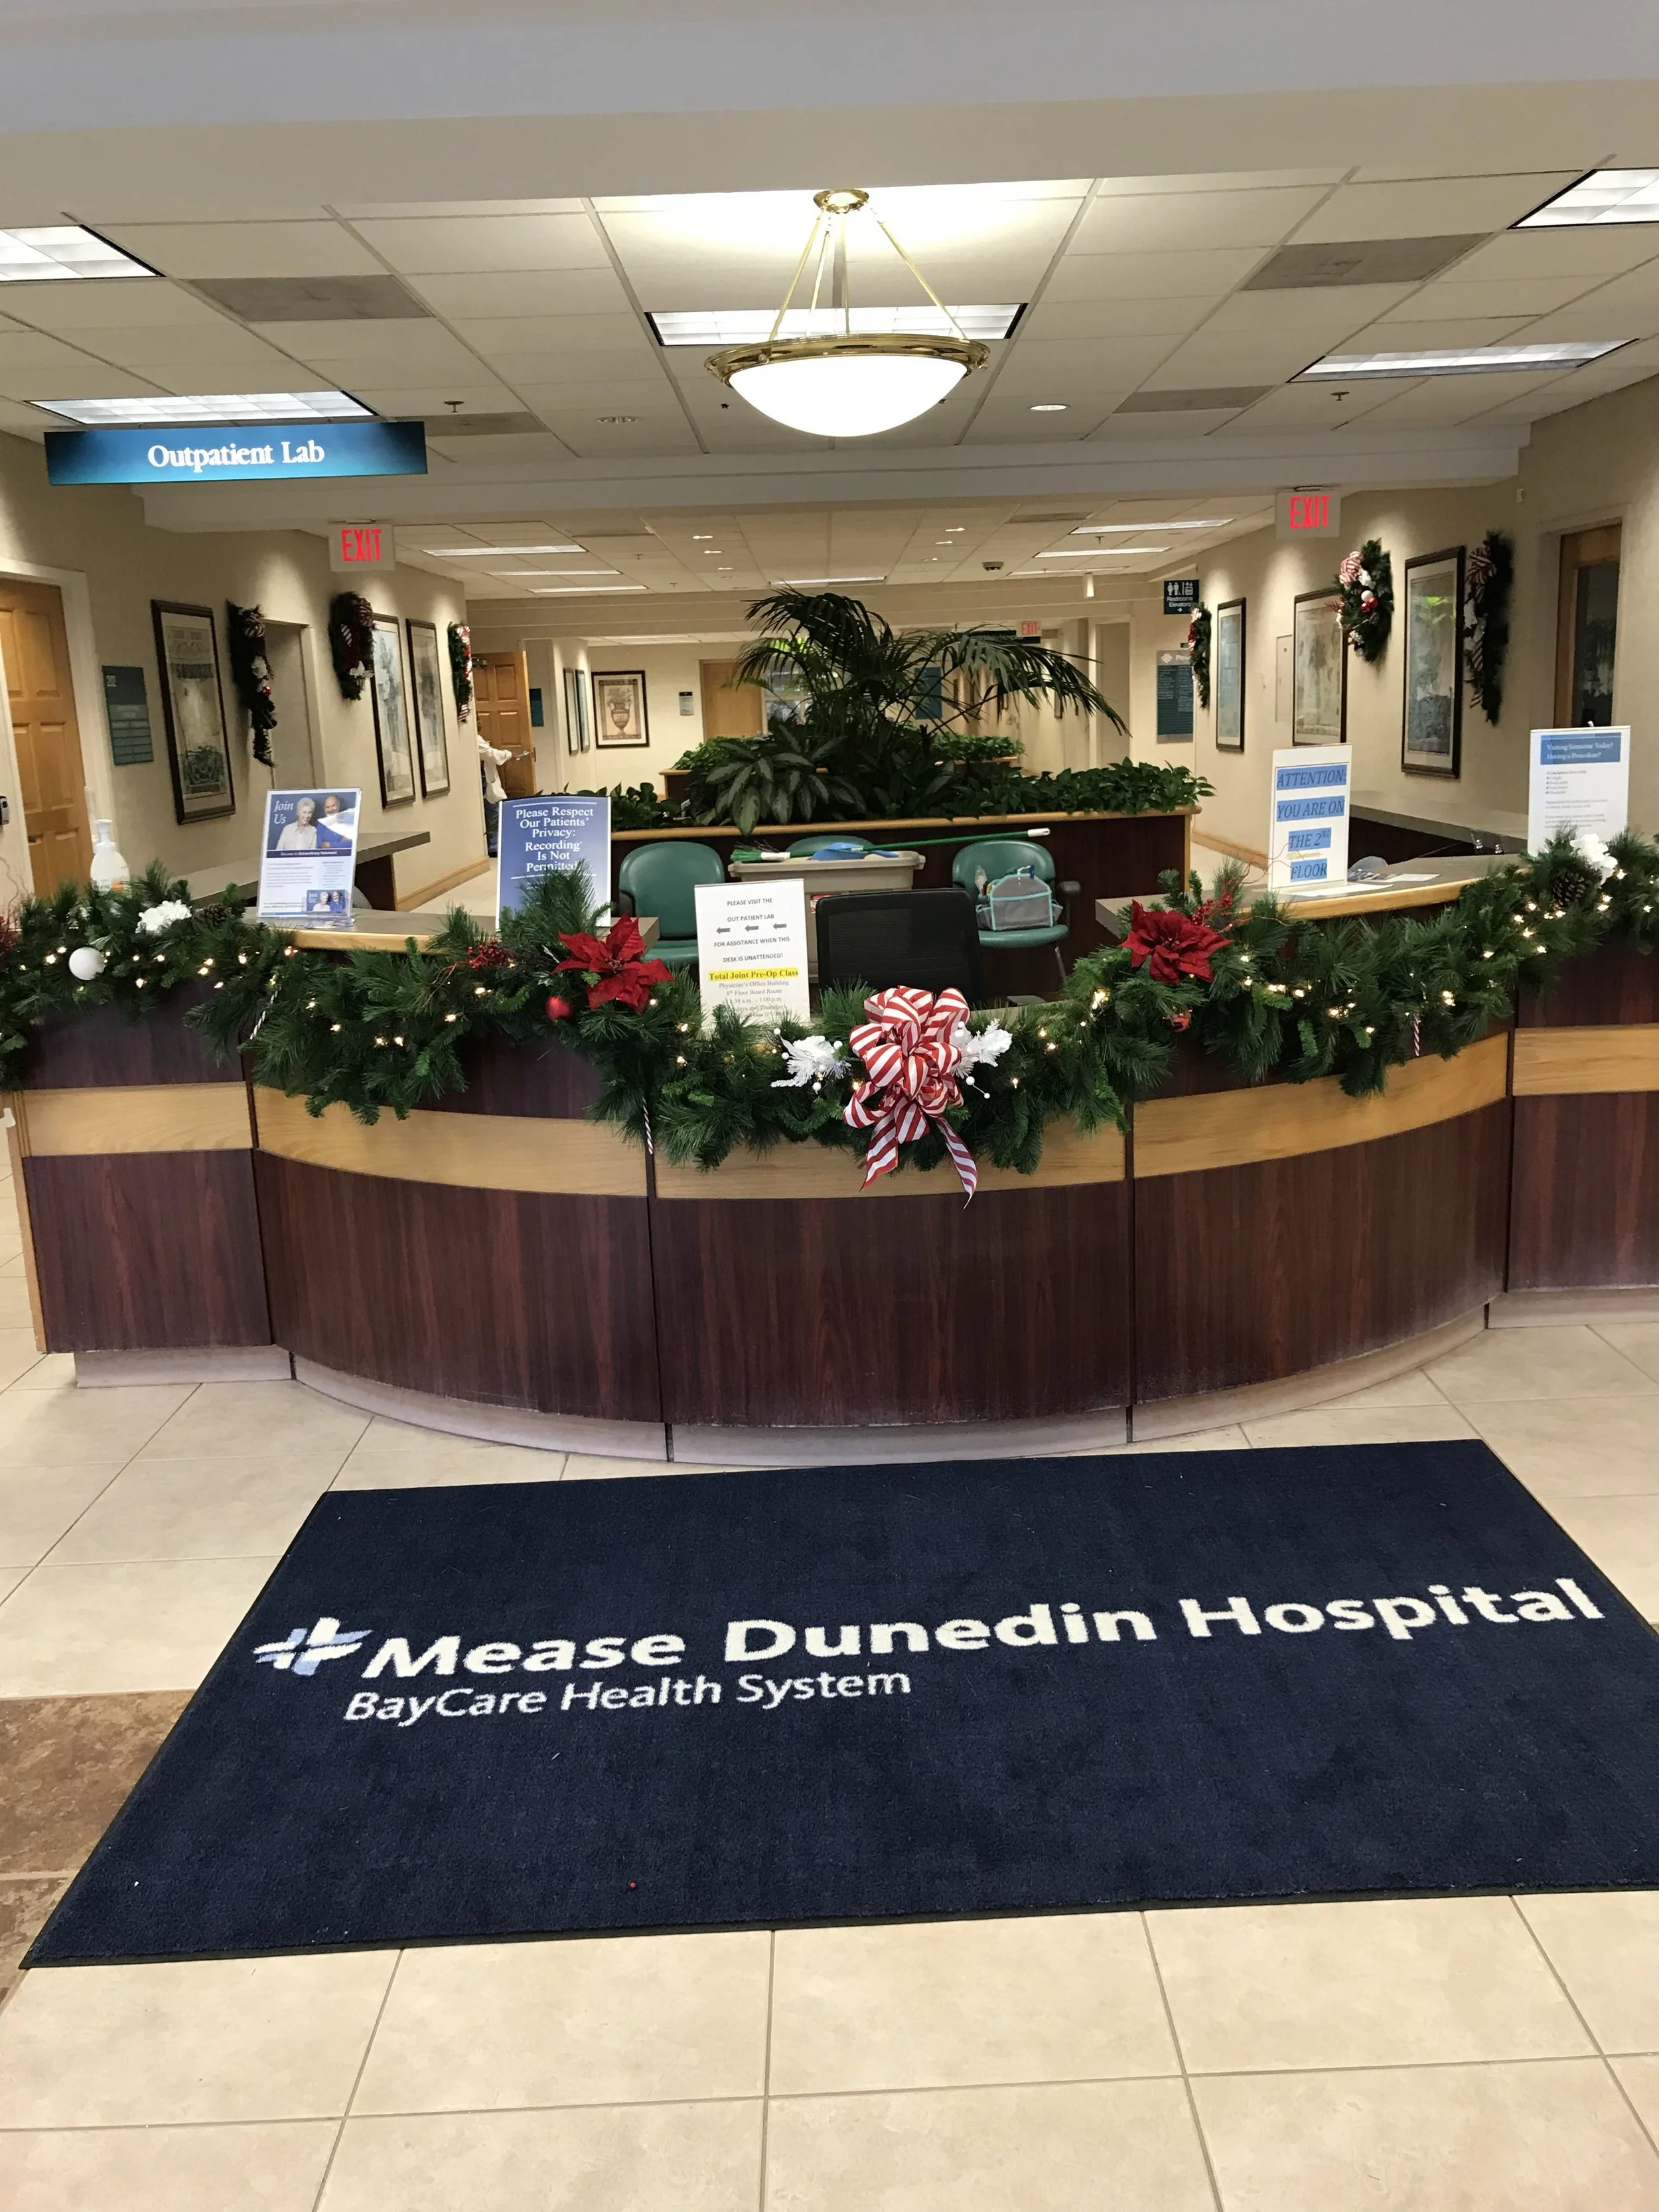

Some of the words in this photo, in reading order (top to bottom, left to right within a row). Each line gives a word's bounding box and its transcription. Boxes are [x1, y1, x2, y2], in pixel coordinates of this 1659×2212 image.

[147, 443, 275, 473] Outpatient
[280, 439, 325, 464] Lab
[1289, 494, 1331, 529] EXIT
[340, 528, 382, 562] EXIT
[1021, 621, 1037, 634] EXIT
[1277, 769, 1346, 788] ATTENTION:
[273, 800, 294, 812] Join
[516, 809, 549, 819] Please
[551, 806, 594, 818] Respect
[1277, 804, 1301, 819] YOU
[1303, 802, 1327, 817] ARE
[1328, 800, 1344, 815] ON
[273, 814, 287, 824] Us
[520, 819, 540, 828] Our
[532, 828, 576, 838] Privacy:
[525, 840, 581, 851] Recording
[1289, 834, 1313, 849] THE
[537, 851, 547, 861] Is
[549, 850, 570, 860] Not
[1290, 862, 1327, 880] FLOOR
[744, 952, 783, 961] UNATTENDED!
[751, 970, 778, 979] Pre-Op
[360, 1633, 687, 1679] Mease
[723, 1601, 1157, 1662] Dunedin
[1179, 1577, 1607, 1641] Hospital
[342, 1689, 549, 1728] BayCare
[559, 1676, 722, 1712] Health
[735, 1669, 912, 1710] System
